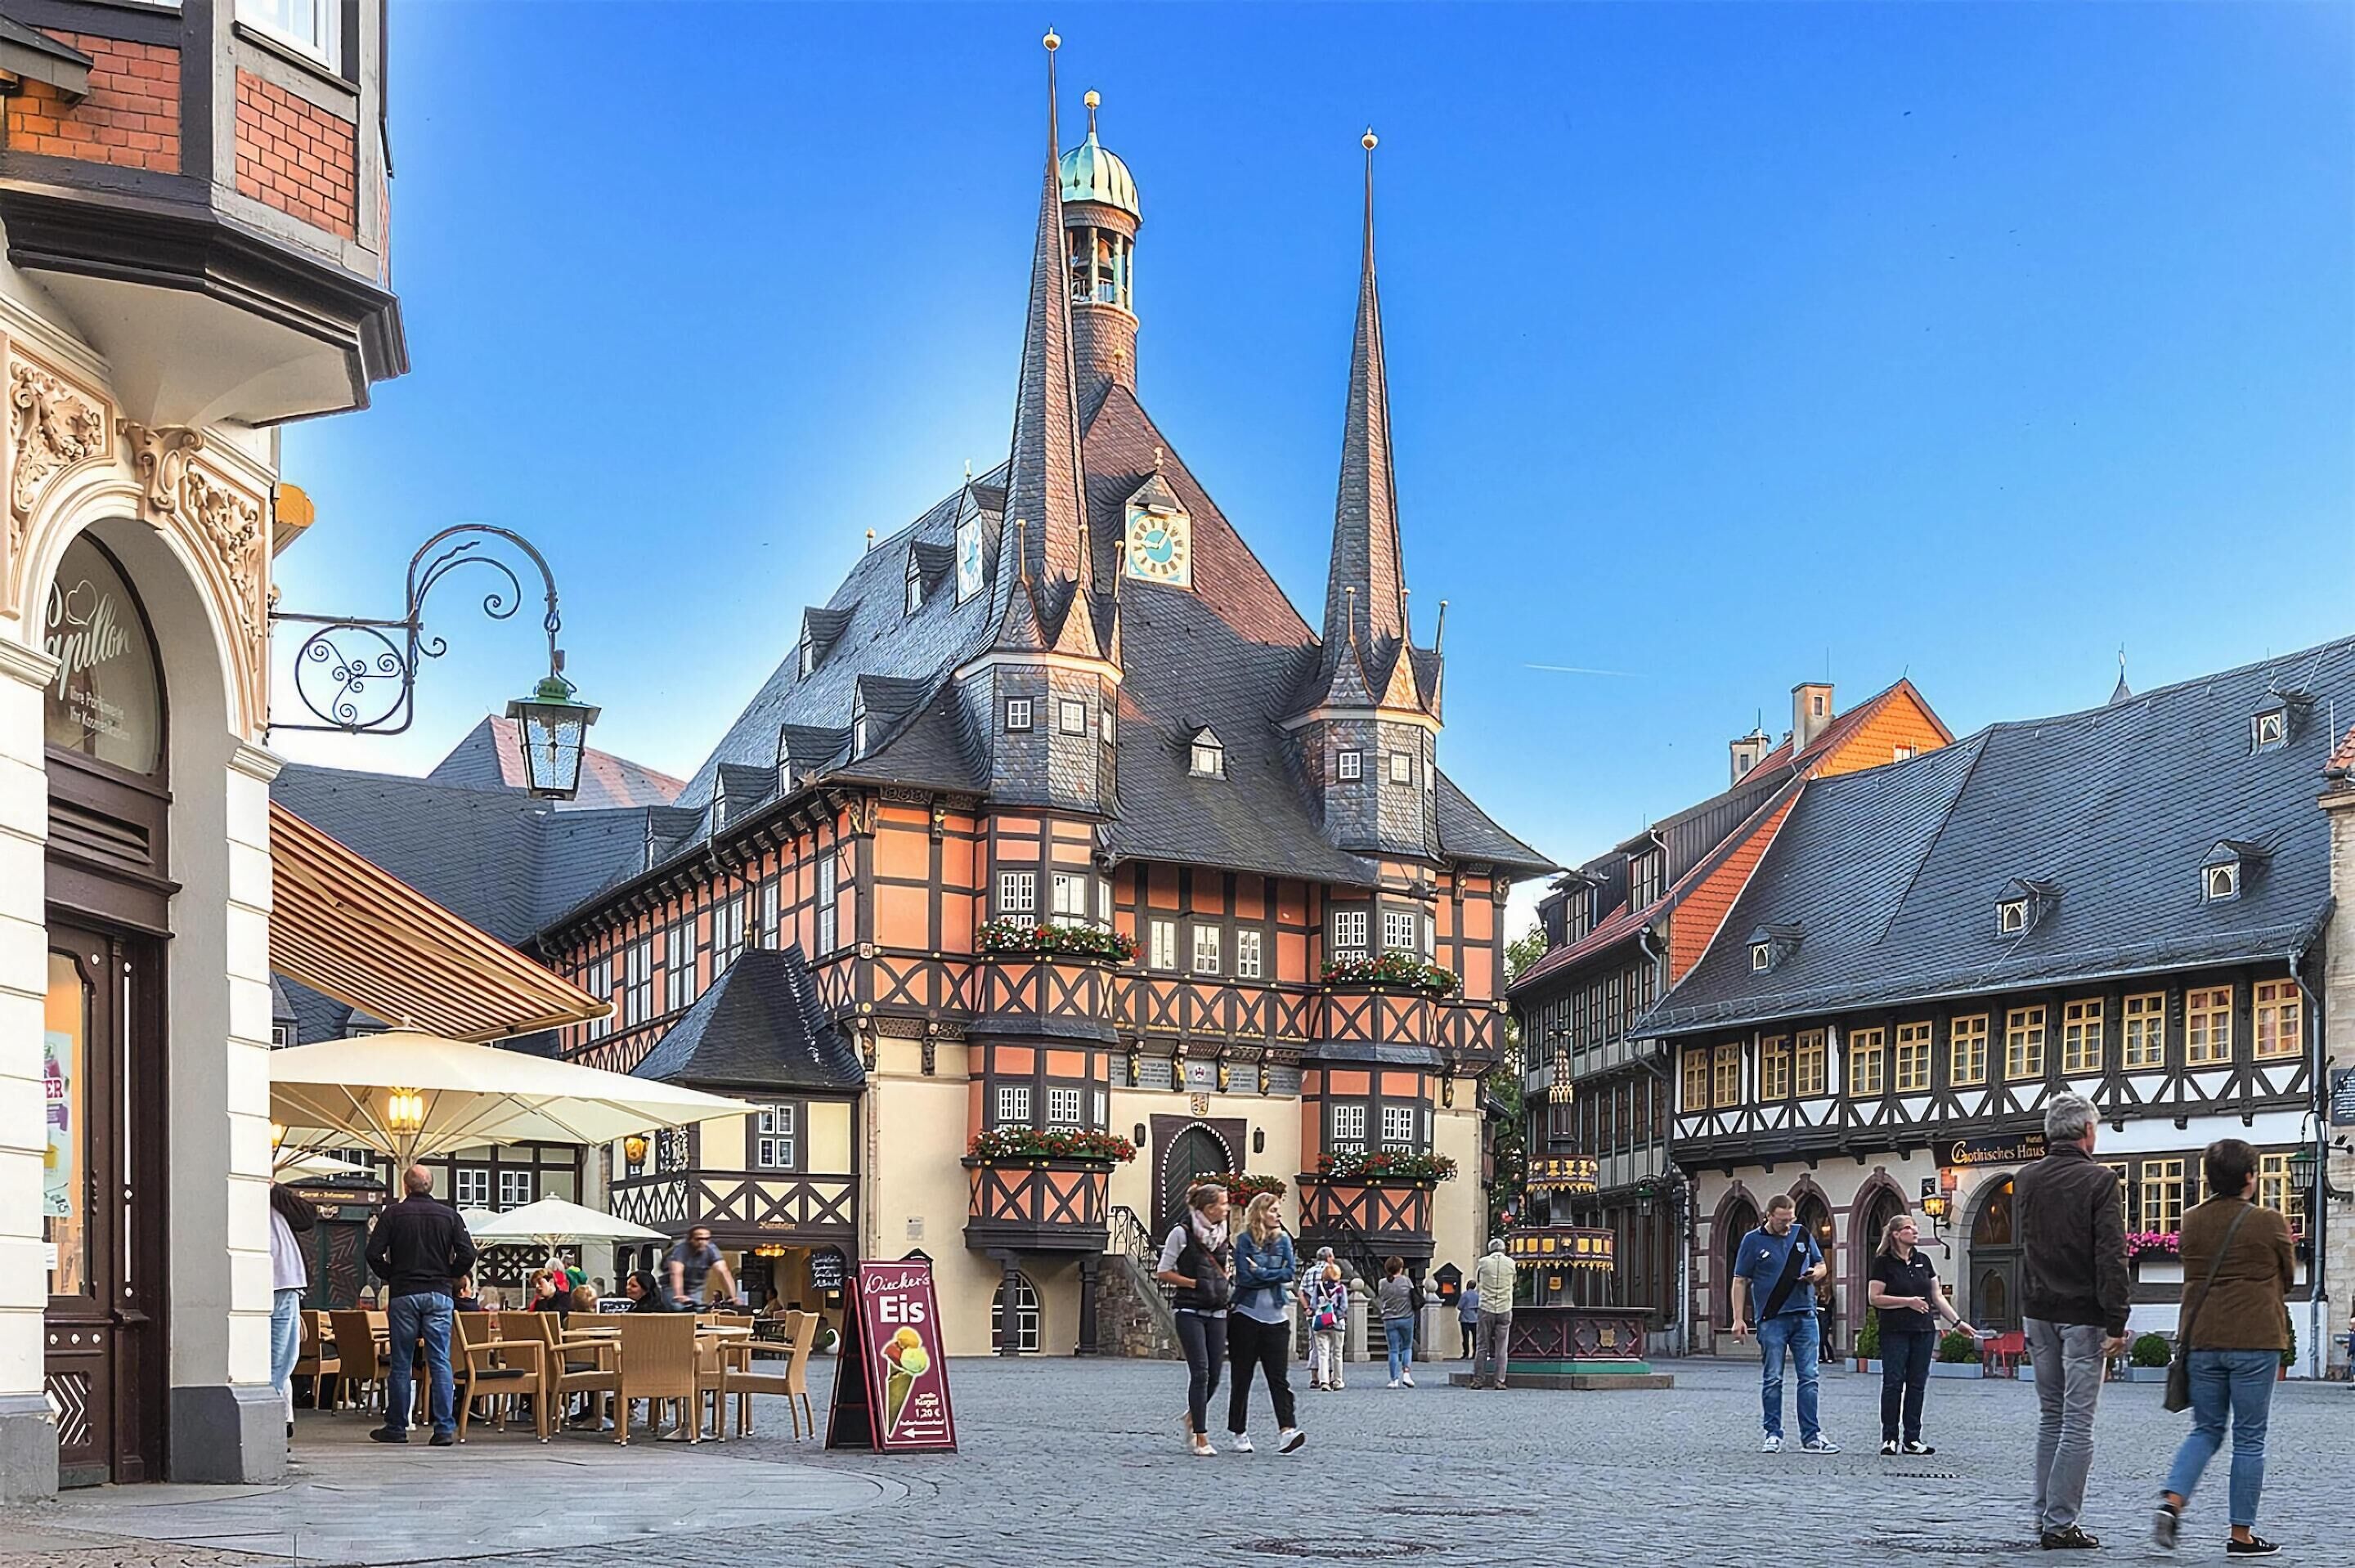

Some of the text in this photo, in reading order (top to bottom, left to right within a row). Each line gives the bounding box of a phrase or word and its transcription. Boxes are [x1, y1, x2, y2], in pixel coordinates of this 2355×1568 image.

[1951, 1140, 2046, 1164] Gothisches Haus
[879, 1293, 926, 1323] Eis
[915, 1397, 940, 1408] Kugel
